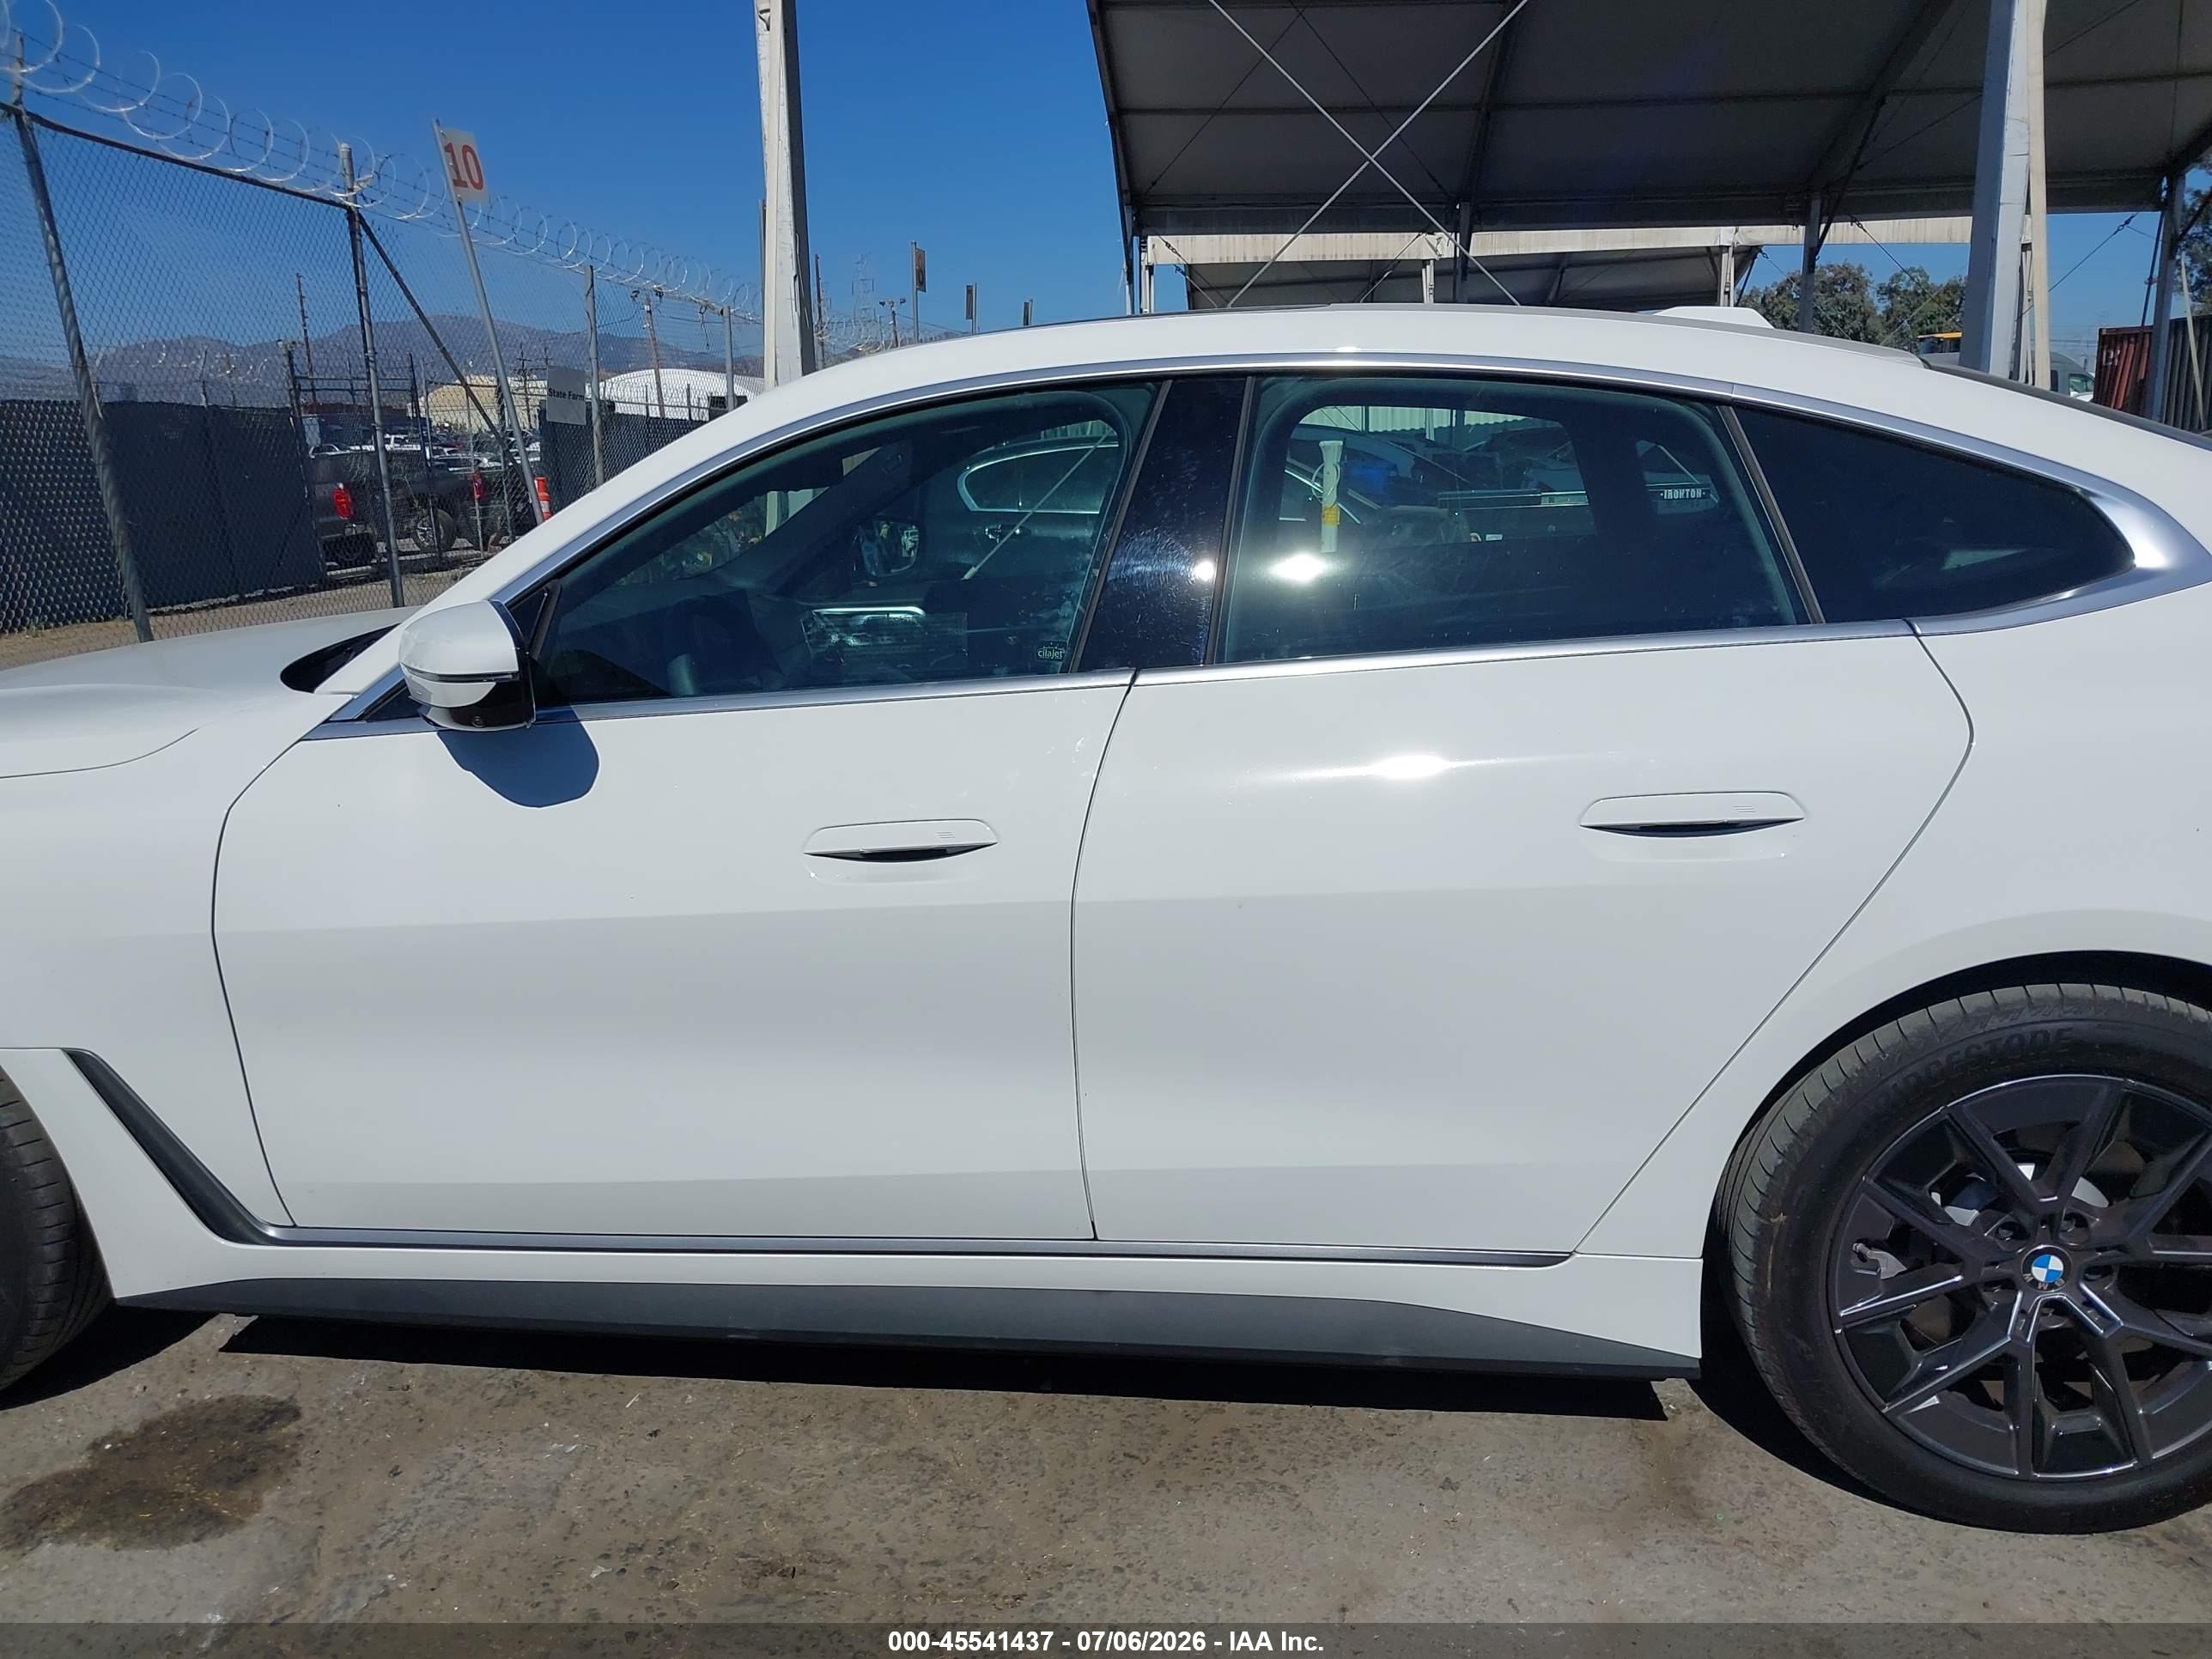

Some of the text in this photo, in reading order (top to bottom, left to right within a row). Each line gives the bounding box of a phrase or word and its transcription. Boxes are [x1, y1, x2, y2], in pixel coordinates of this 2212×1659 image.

[444, 142, 483, 191] 10
[548, 387, 585, 402] State Farm
[1870, 1027, 2075, 1109] IDGESTONE
[2022, 1272, 2065, 1290] BMW
